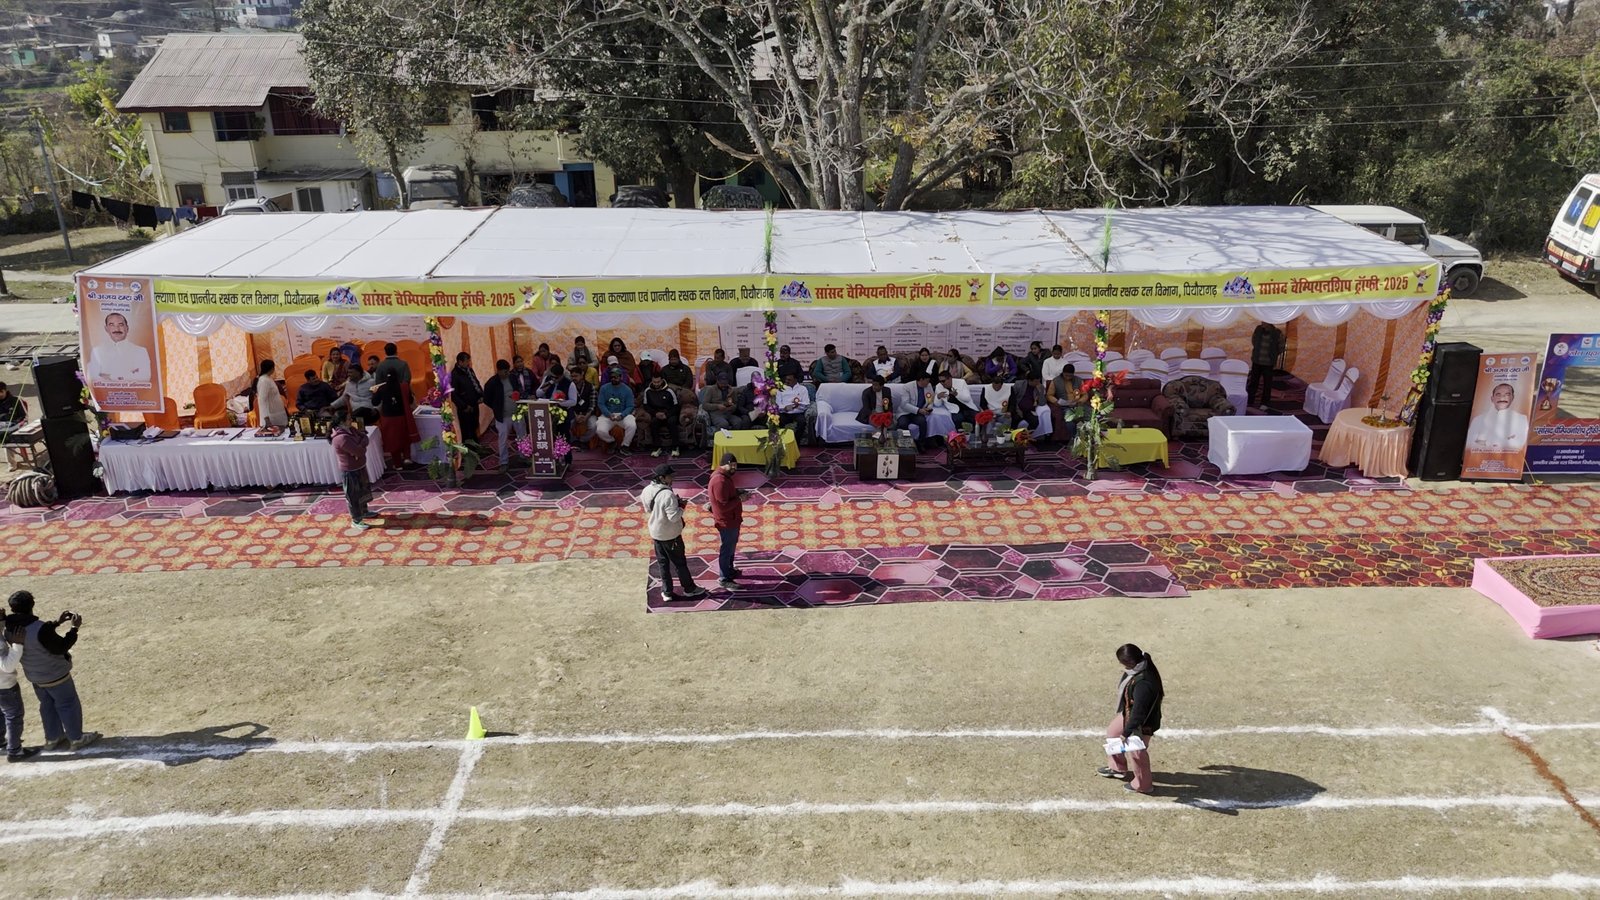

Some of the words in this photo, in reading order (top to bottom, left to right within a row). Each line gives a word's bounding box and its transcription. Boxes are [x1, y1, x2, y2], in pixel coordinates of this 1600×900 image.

[815, 283, 844, 300] सांसद
[846, 283, 907, 300] चैम्पियनशिप
[1034, 286, 1048, 301] युवा
[1050, 285, 1078, 299] कल्याण
[1080, 284, 1091, 298] एवं
[1092, 283, 1118, 299] प्रान्तीय
[1120, 285, 1139, 298] रक्षक
[1141, 285, 1153, 298] दल
[1258, 278, 1288, 295] सांसद
[1290, 277, 1352, 294] चैम्पियनशिप
[154, 292, 176, 304] ल्याण
[178, 290, 189, 304] एवं
[190, 288, 217, 305] प्रान्तीय
[219, 292, 239, 306] रक्षक
[241, 292, 253, 306] दल
[361, 289, 393, 307] सांसद
[394, 289, 458, 308] चैम्पियनशिप
[592, 291, 606, 307] युवा
[608, 290, 636, 304] कल्याण
[638, 288, 649, 303] एवं
[650, 287, 676, 303] प्रान्तीय
[678, 289, 697, 302] रक्षक
[699, 289, 711, 302] दल
